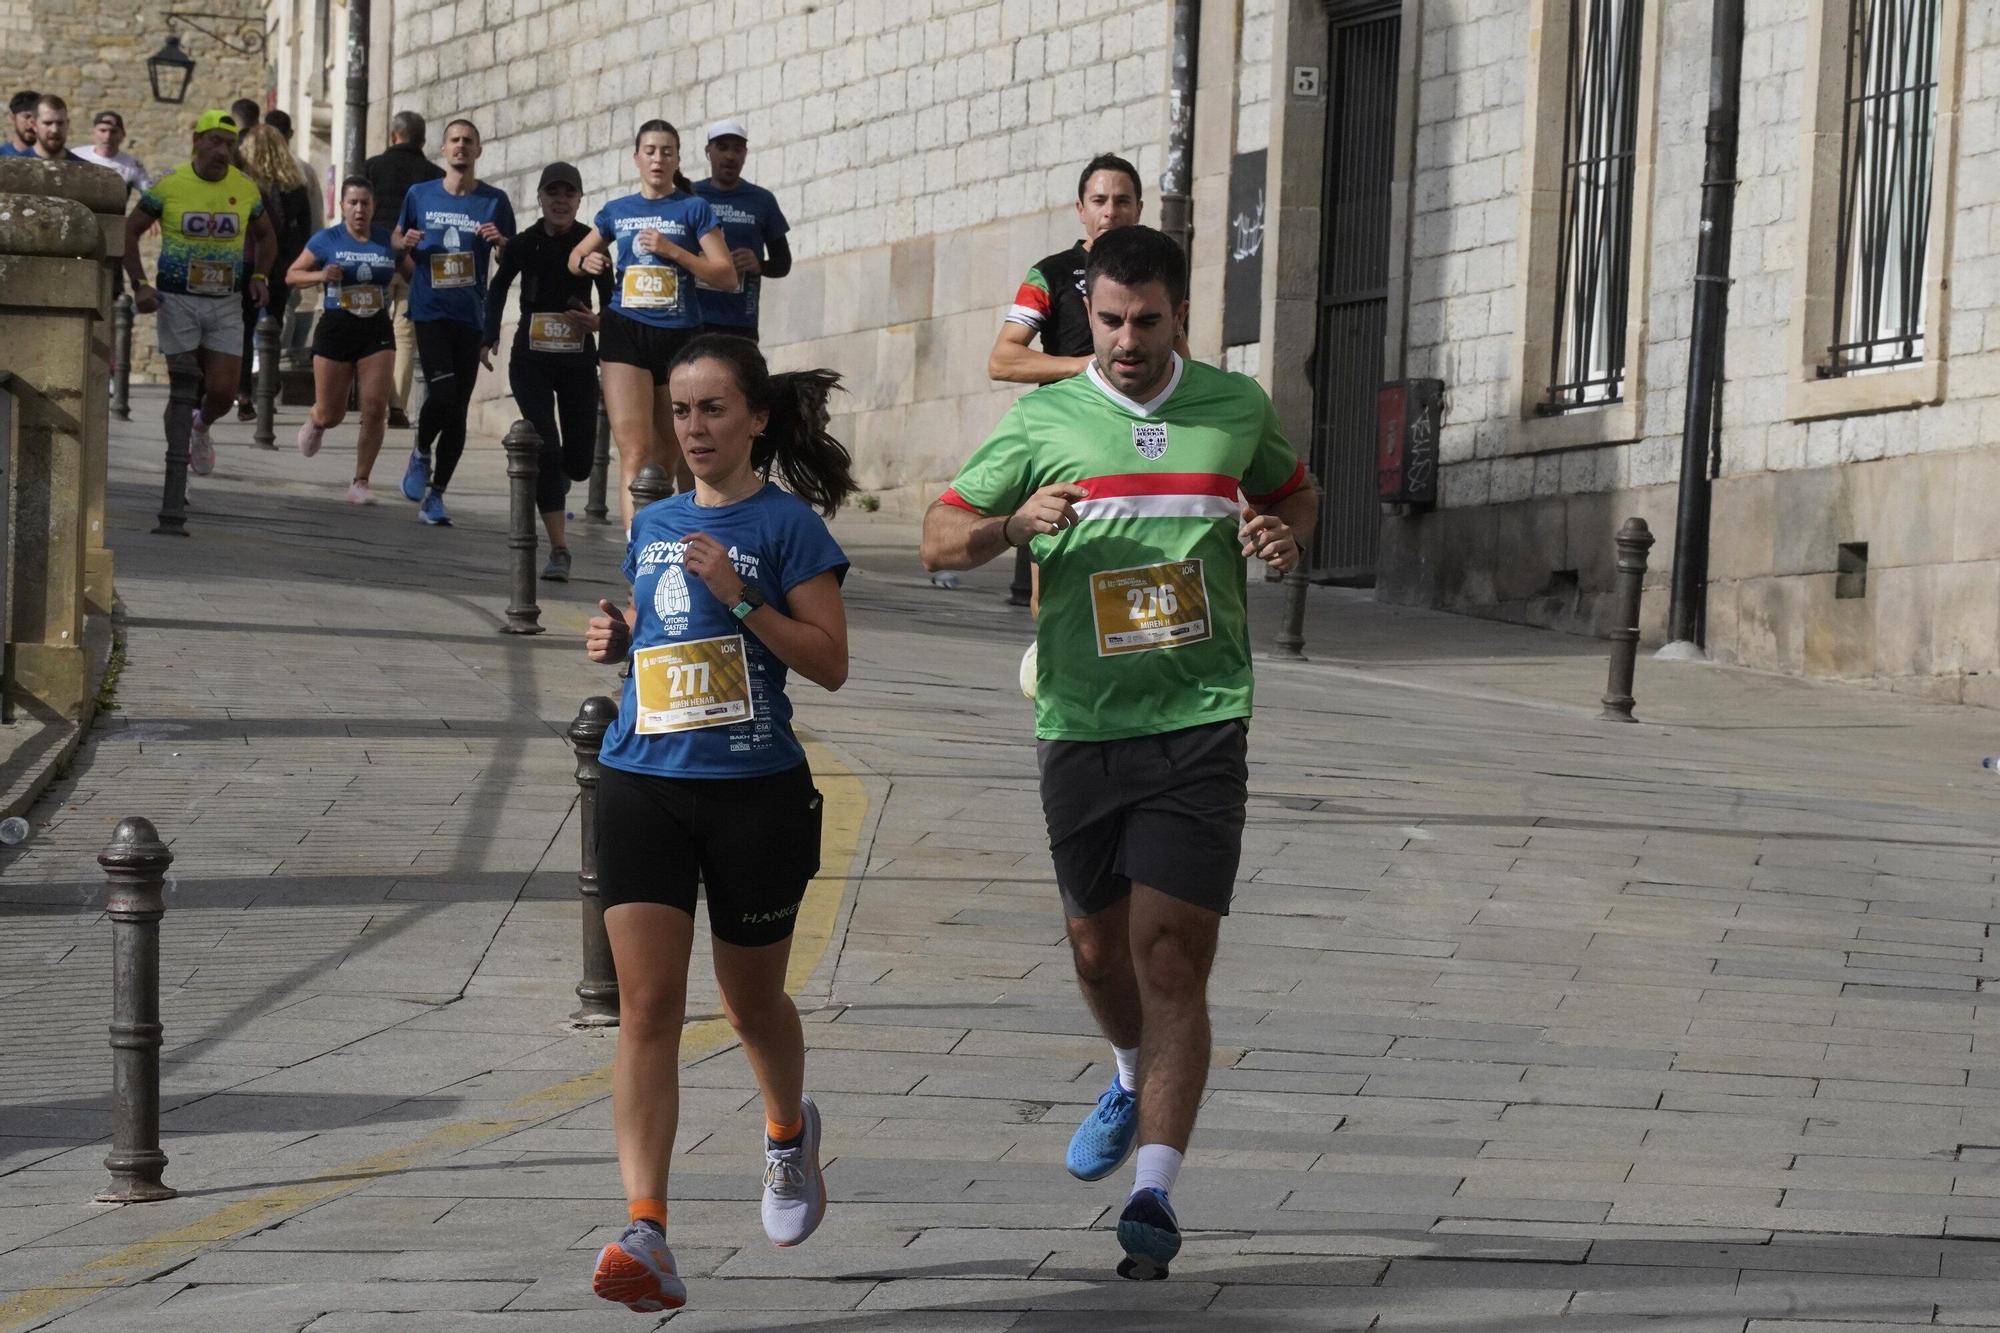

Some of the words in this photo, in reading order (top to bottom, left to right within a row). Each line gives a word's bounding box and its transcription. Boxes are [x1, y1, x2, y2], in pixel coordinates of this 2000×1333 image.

[1298, 71, 1314, 92] 5
[622, 219, 677, 231] ALMENDRA
[635, 276, 663, 292] 425
[544, 322, 571, 338] 552
[740, 554, 760, 566] REN
[1126, 583, 1178, 620] 276
[664, 616, 689, 624] VITORIA
[1140, 620, 1164, 630] MIREN
[663, 623, 689, 632] GASTEIZ
[720, 643, 737, 654] 10K
[666, 661, 710, 699] 277
[669, 699, 689, 710] MIREN
[690, 695, 715, 707] HENAR
